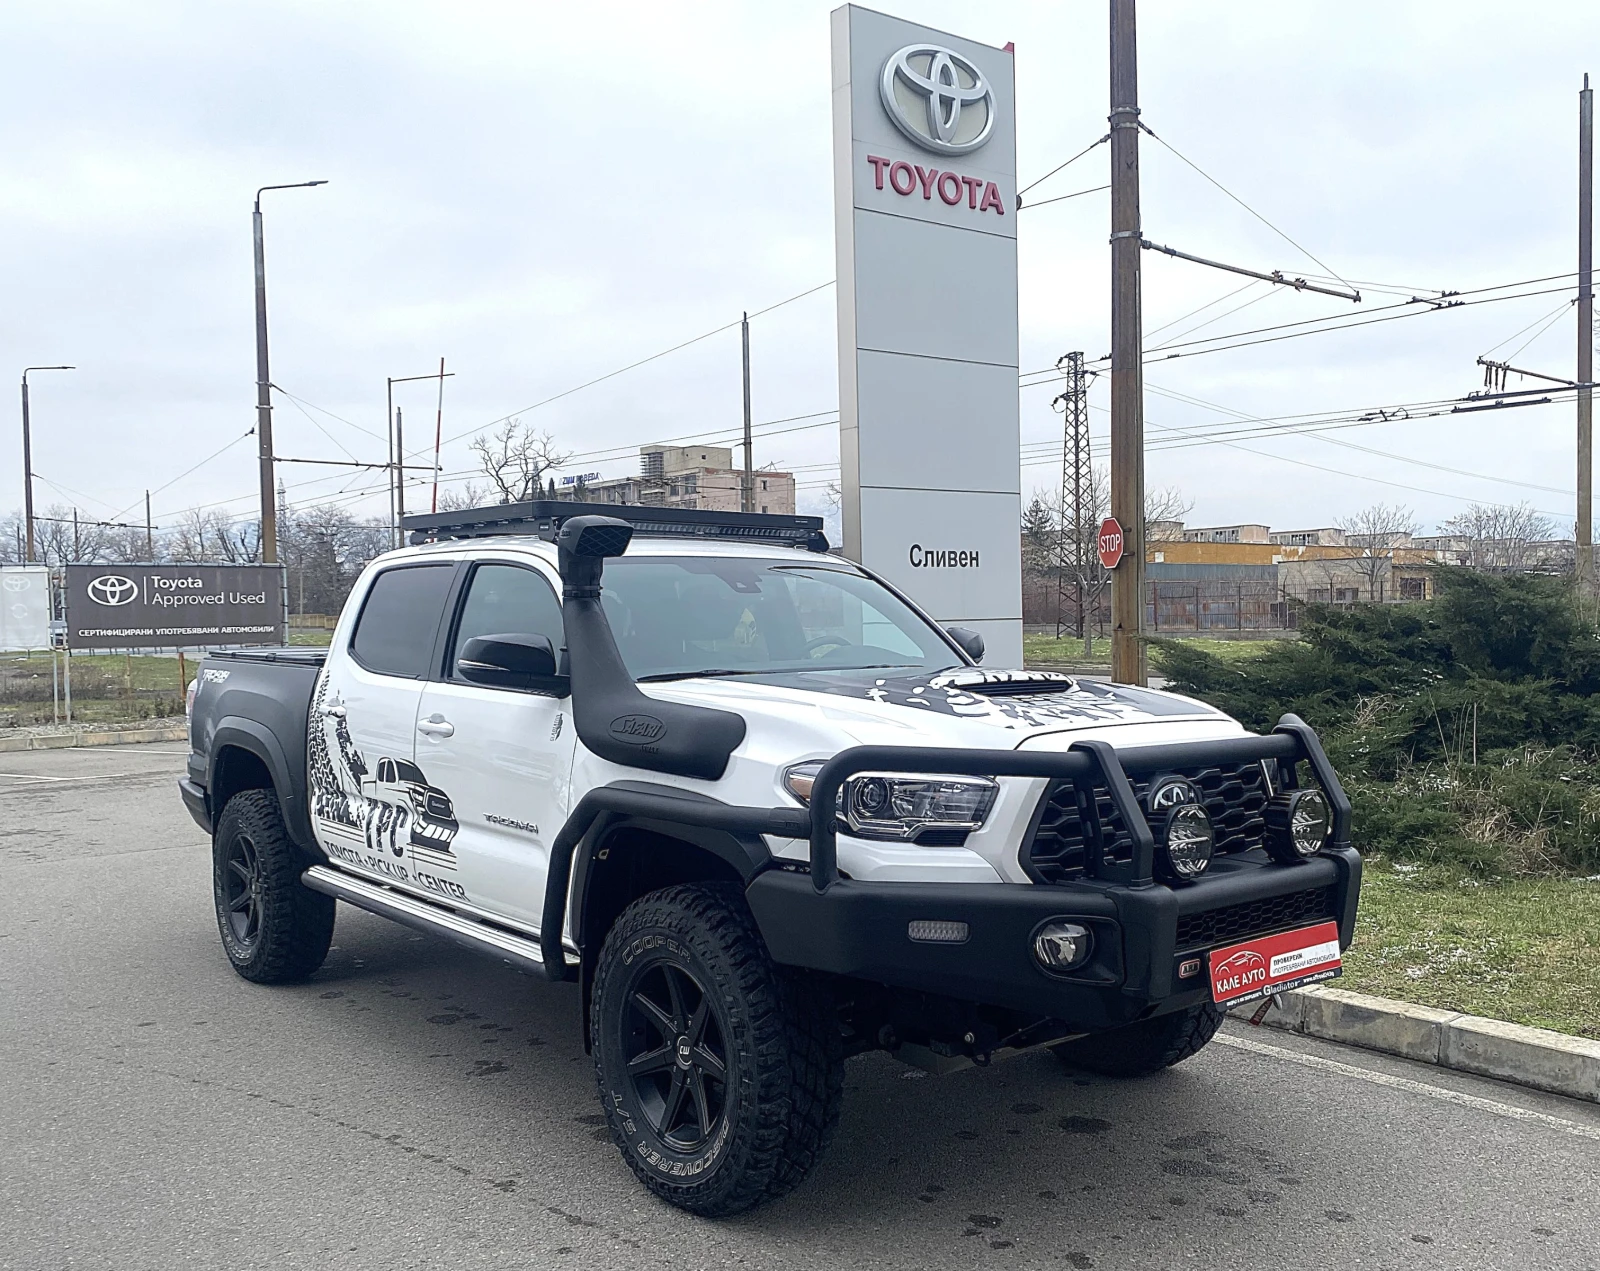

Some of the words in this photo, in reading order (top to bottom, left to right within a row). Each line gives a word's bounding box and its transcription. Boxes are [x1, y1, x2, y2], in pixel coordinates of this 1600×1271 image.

[867, 154, 1004, 215] TOYOTA
[1100, 533, 1120, 553] STOP
[909, 543, 979, 568] Сливен
[151, 575, 202, 591] Toyota
[152, 592, 224, 608] Approved
[229, 592, 265, 604] Used
[78, 628, 153, 637] СЕРТИФИЦИРАНИ
[155, 627, 219, 636] УПОТРЕБЯВАНИ
[221, 625, 274, 634] АВТОМОБИЛИ
[612, 717, 663, 738] SAFARI
[482, 812, 539, 835] TACOMA
[324, 840, 364, 866] TOYOTA
[369, 855, 393, 877] PICK
[393, 863, 413, 881] UP
[418, 871, 470, 902] CENTER
[622, 935, 691, 965] COOPER
[1306, 952, 1336, 967] АВТОМОБИЛИ
[1216, 974, 1241, 994] КАЛЕ
[1241, 966, 1266, 987] АУТО
[1262, 979, 1301, 996] Gladiator
[611, 1090, 637, 1135] S/T
[637, 1115, 729, 1176] DISCOVERER
